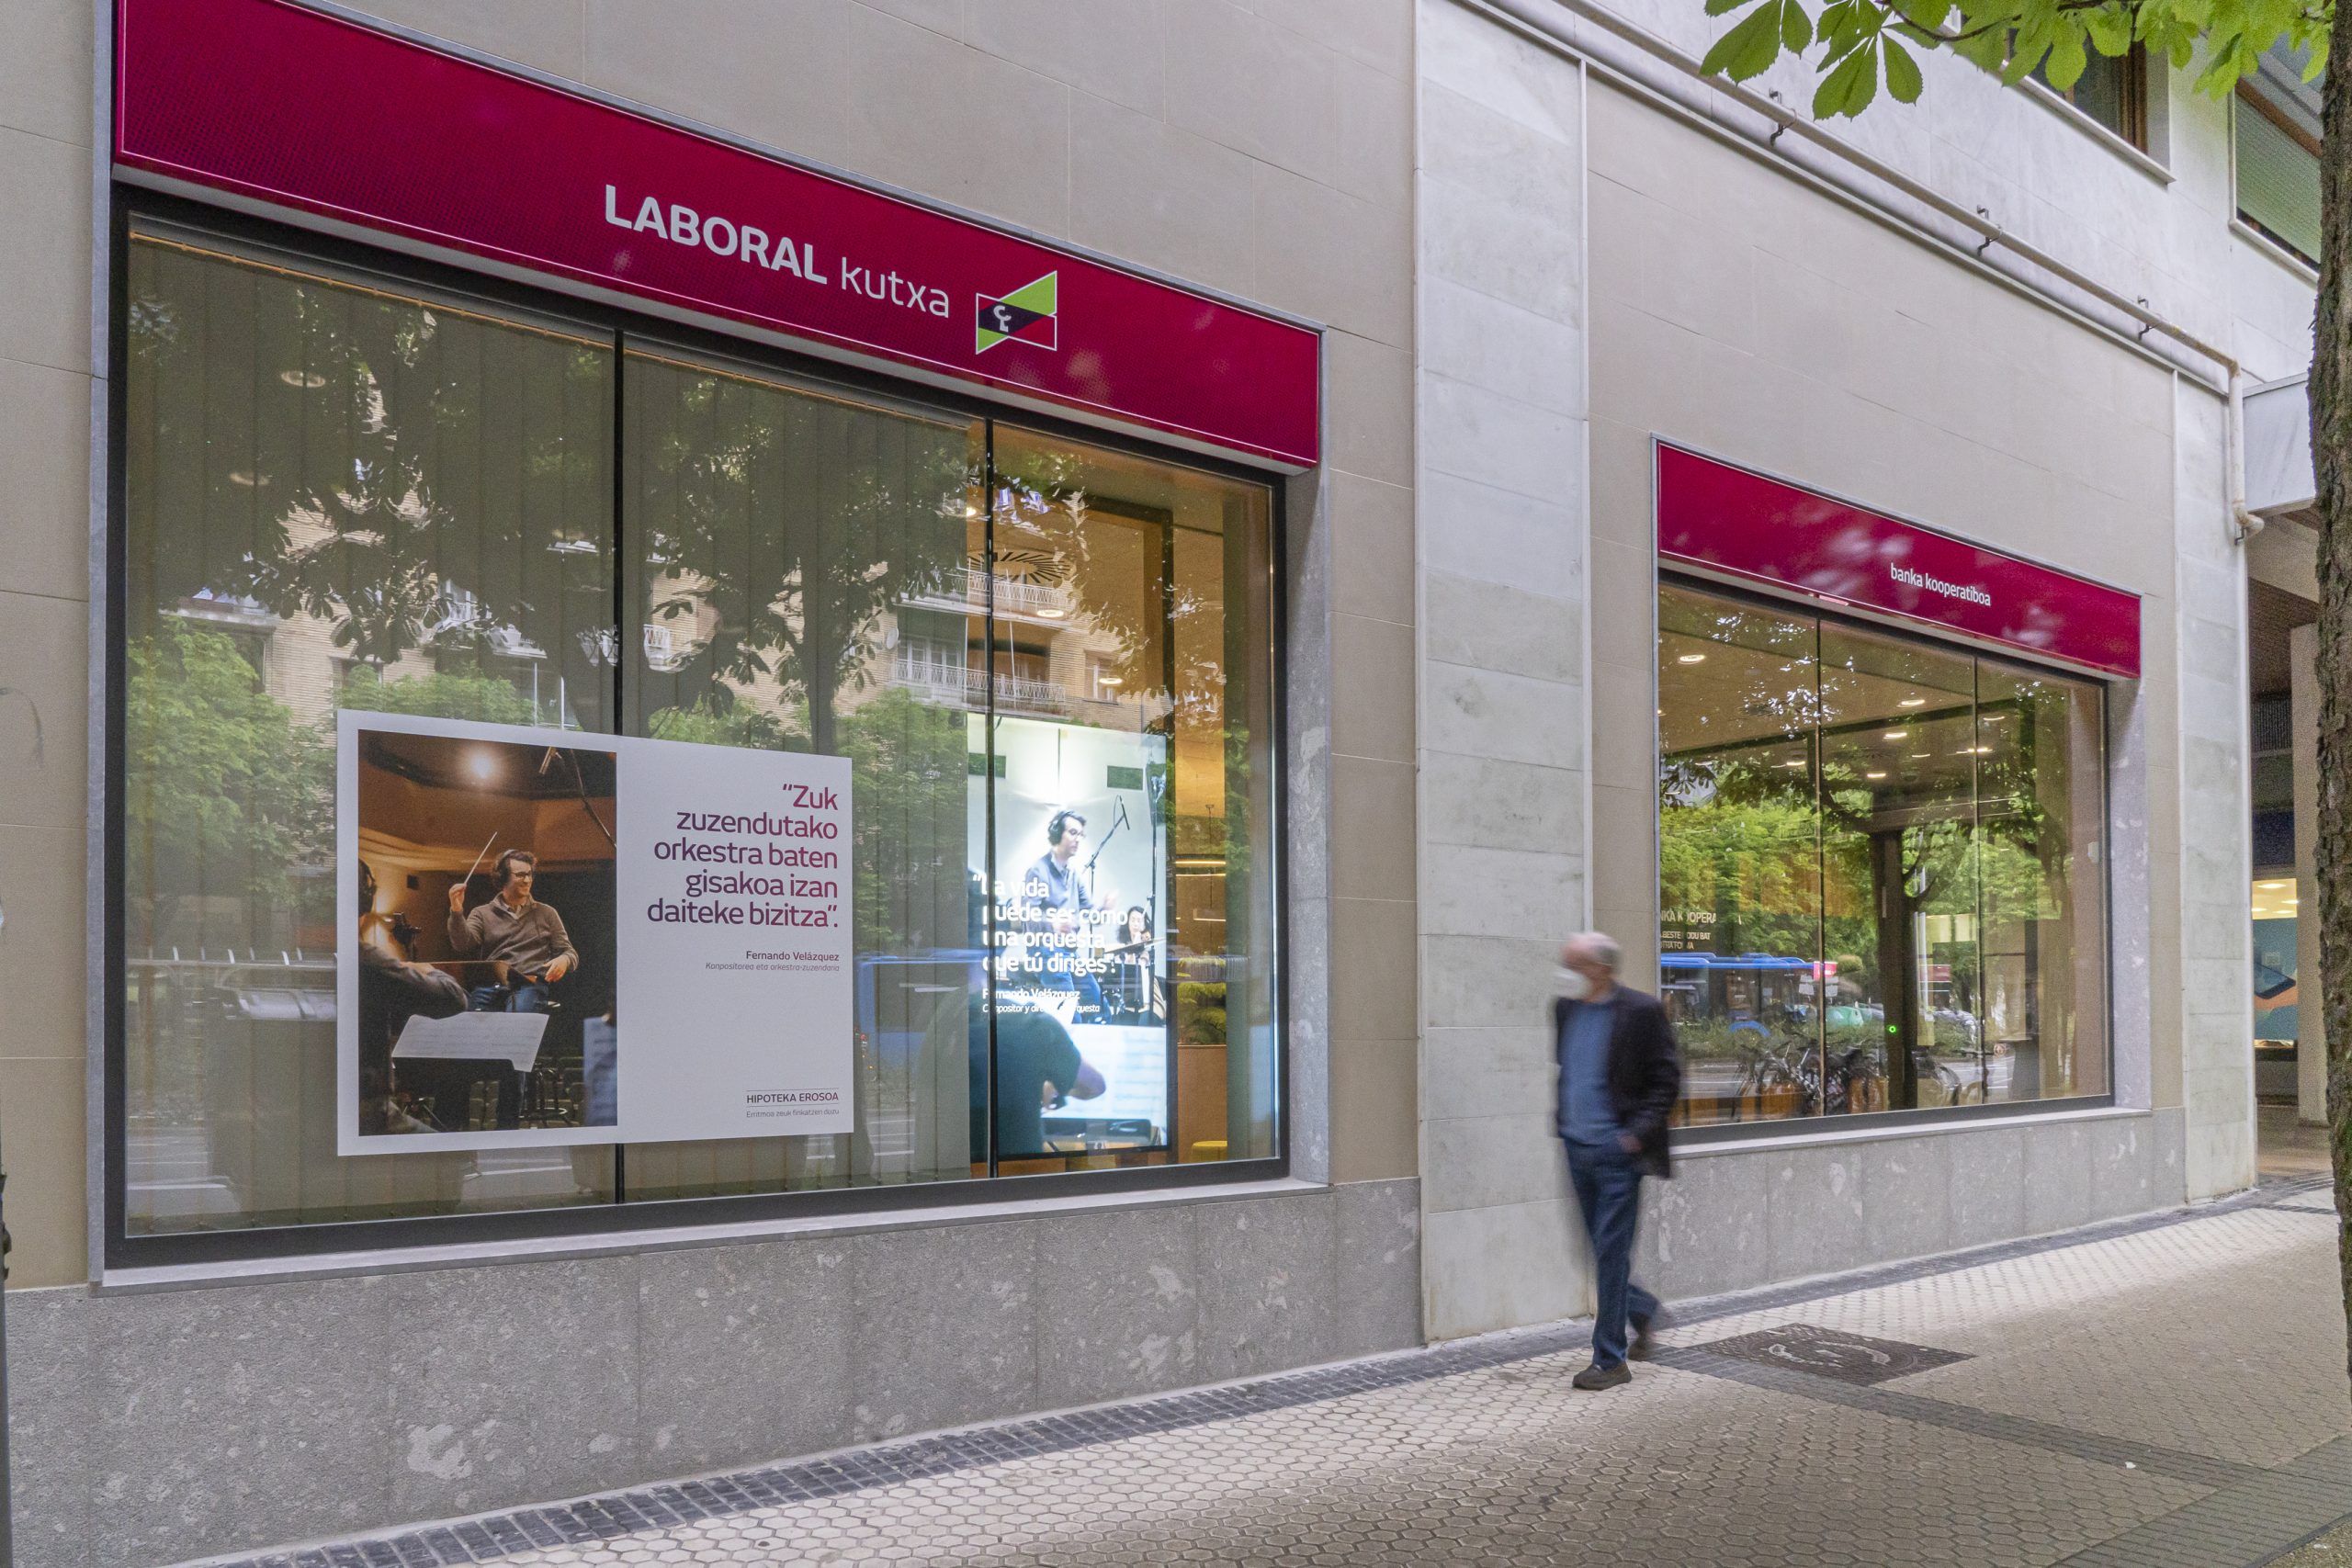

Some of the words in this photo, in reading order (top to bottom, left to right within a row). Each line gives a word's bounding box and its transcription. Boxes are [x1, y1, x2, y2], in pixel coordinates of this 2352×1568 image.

[605, 184, 828, 285] LABORAL
[841, 256, 949, 319] kutxa
[1890, 562, 1923, 588] banka
[1925, 572, 1992, 606] kooperatiboa
[782, 783, 839, 810] “Zuk
[676, 811, 839, 840] zuzendutako
[653, 837, 763, 865] orkestra
[768, 842, 838, 869] baten
[685, 869, 785, 897] gisakoa
[789, 874, 838, 898] izan
[1010, 877, 1050, 897] vida
[647, 897, 744, 925] daiteke
[1046, 907, 1076, 922] ser
[1079, 908, 1128, 926] como
[1023, 931, 1105, 952] orquesta
[745, 950, 791, 961] Fernando
[792, 951, 840, 963] Velázquez
[756, 963, 769, 971] eta
[1023, 953, 1043, 972] tú
[982, 987, 1030, 999] Frnando
[1030, 987, 1080, 1000] Velázquez
[746, 1092, 797, 1104] HIPOTEKA
[798, 1091, 839, 1102] EROSOA
